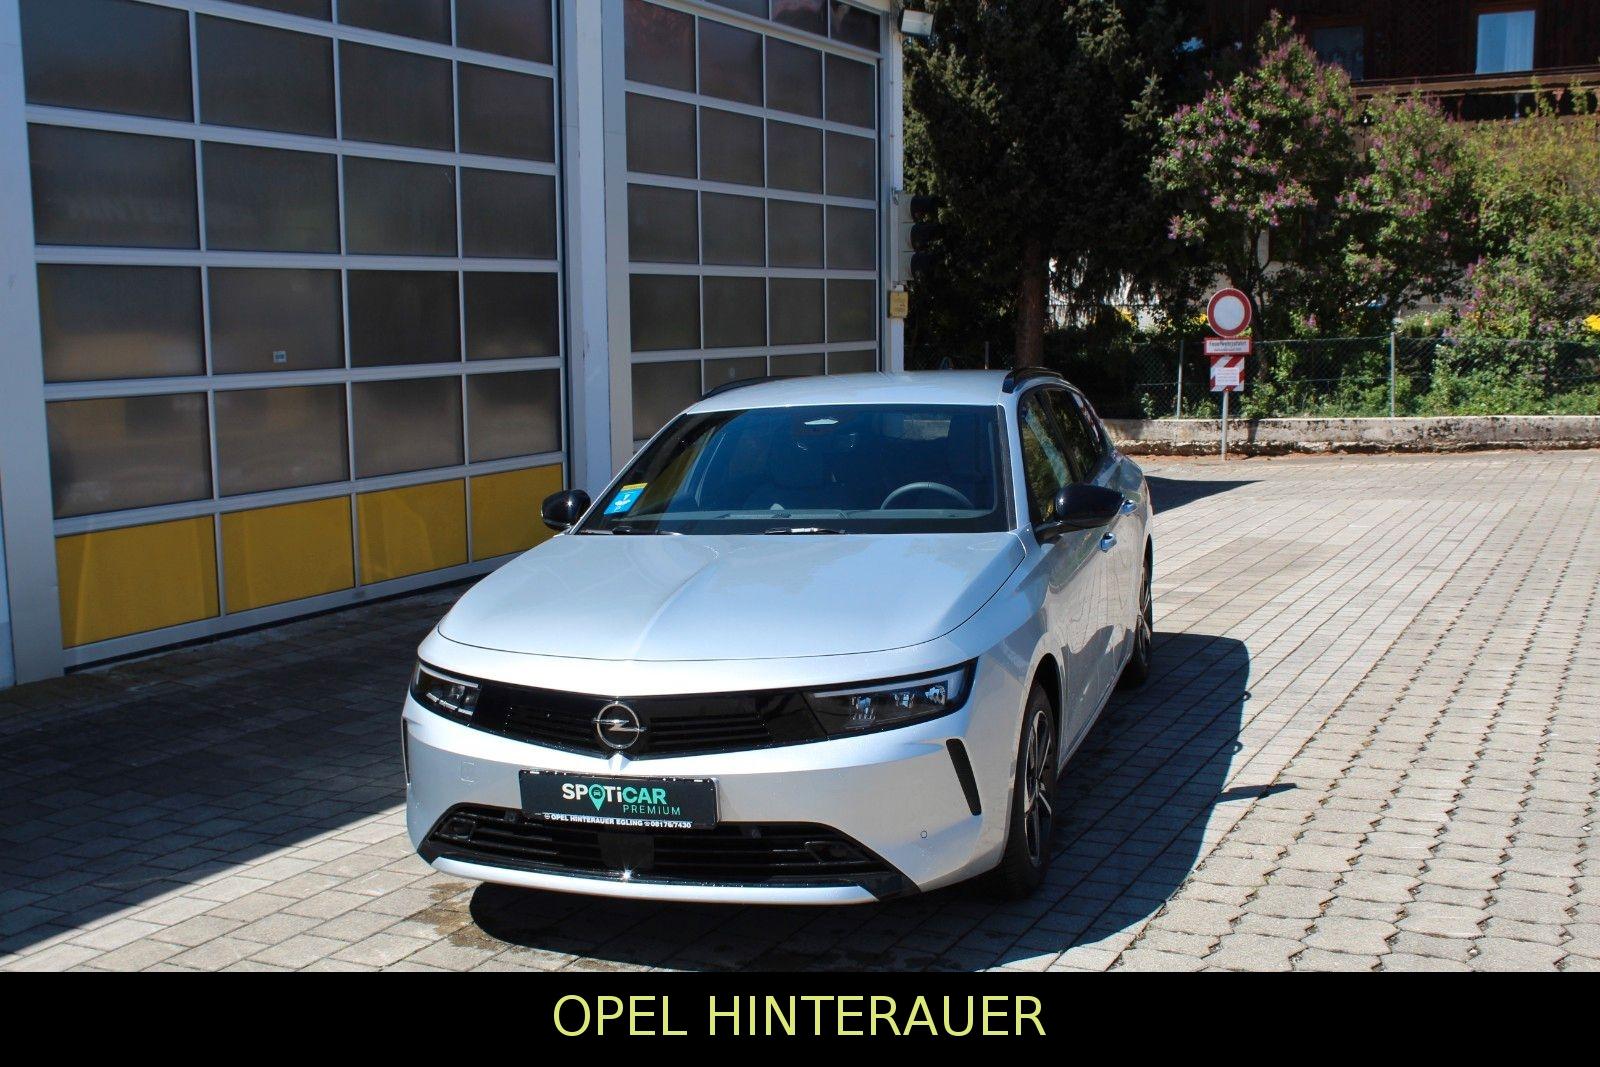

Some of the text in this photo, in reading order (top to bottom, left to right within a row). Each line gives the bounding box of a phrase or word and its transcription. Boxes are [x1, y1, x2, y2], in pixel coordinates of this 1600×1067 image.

[623, 804, 681, 816] PREMIUM
[551, 814, 569, 822] OPEL
[570, 815, 615, 824] HINTERAUER
[616, 818, 643, 826] EGLING
